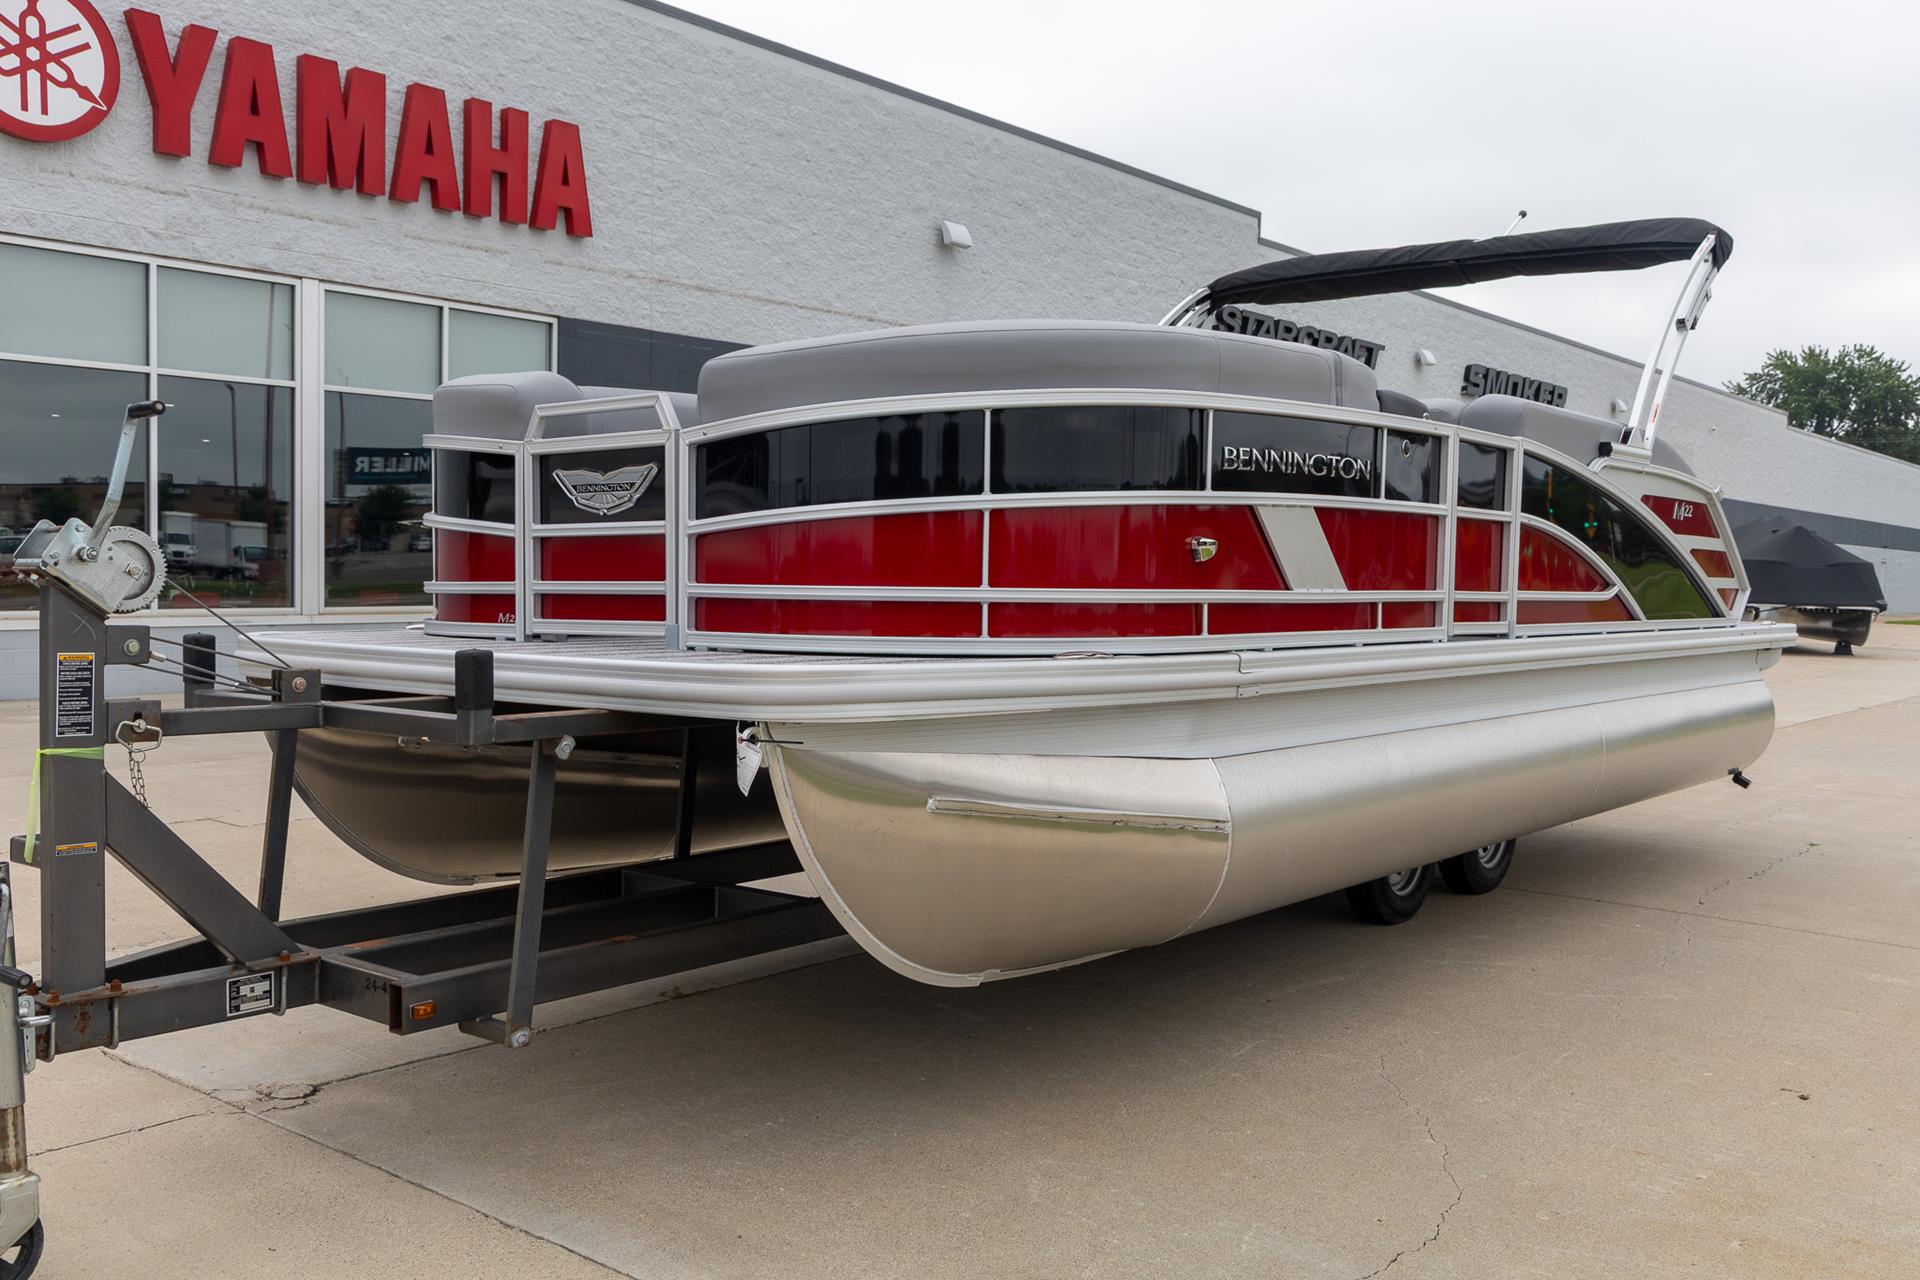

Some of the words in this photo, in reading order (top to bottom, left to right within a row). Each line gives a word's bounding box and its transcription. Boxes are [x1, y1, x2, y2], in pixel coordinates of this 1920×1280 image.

[123, 7, 593, 238] YAMAHA
[1215, 305, 1385, 370] STARCRAFT
[1461, 363, 1568, 408] SMOKER
[1223, 446, 1371, 481] BENNINGTON
[576, 483, 631, 493] BENNINGTON
